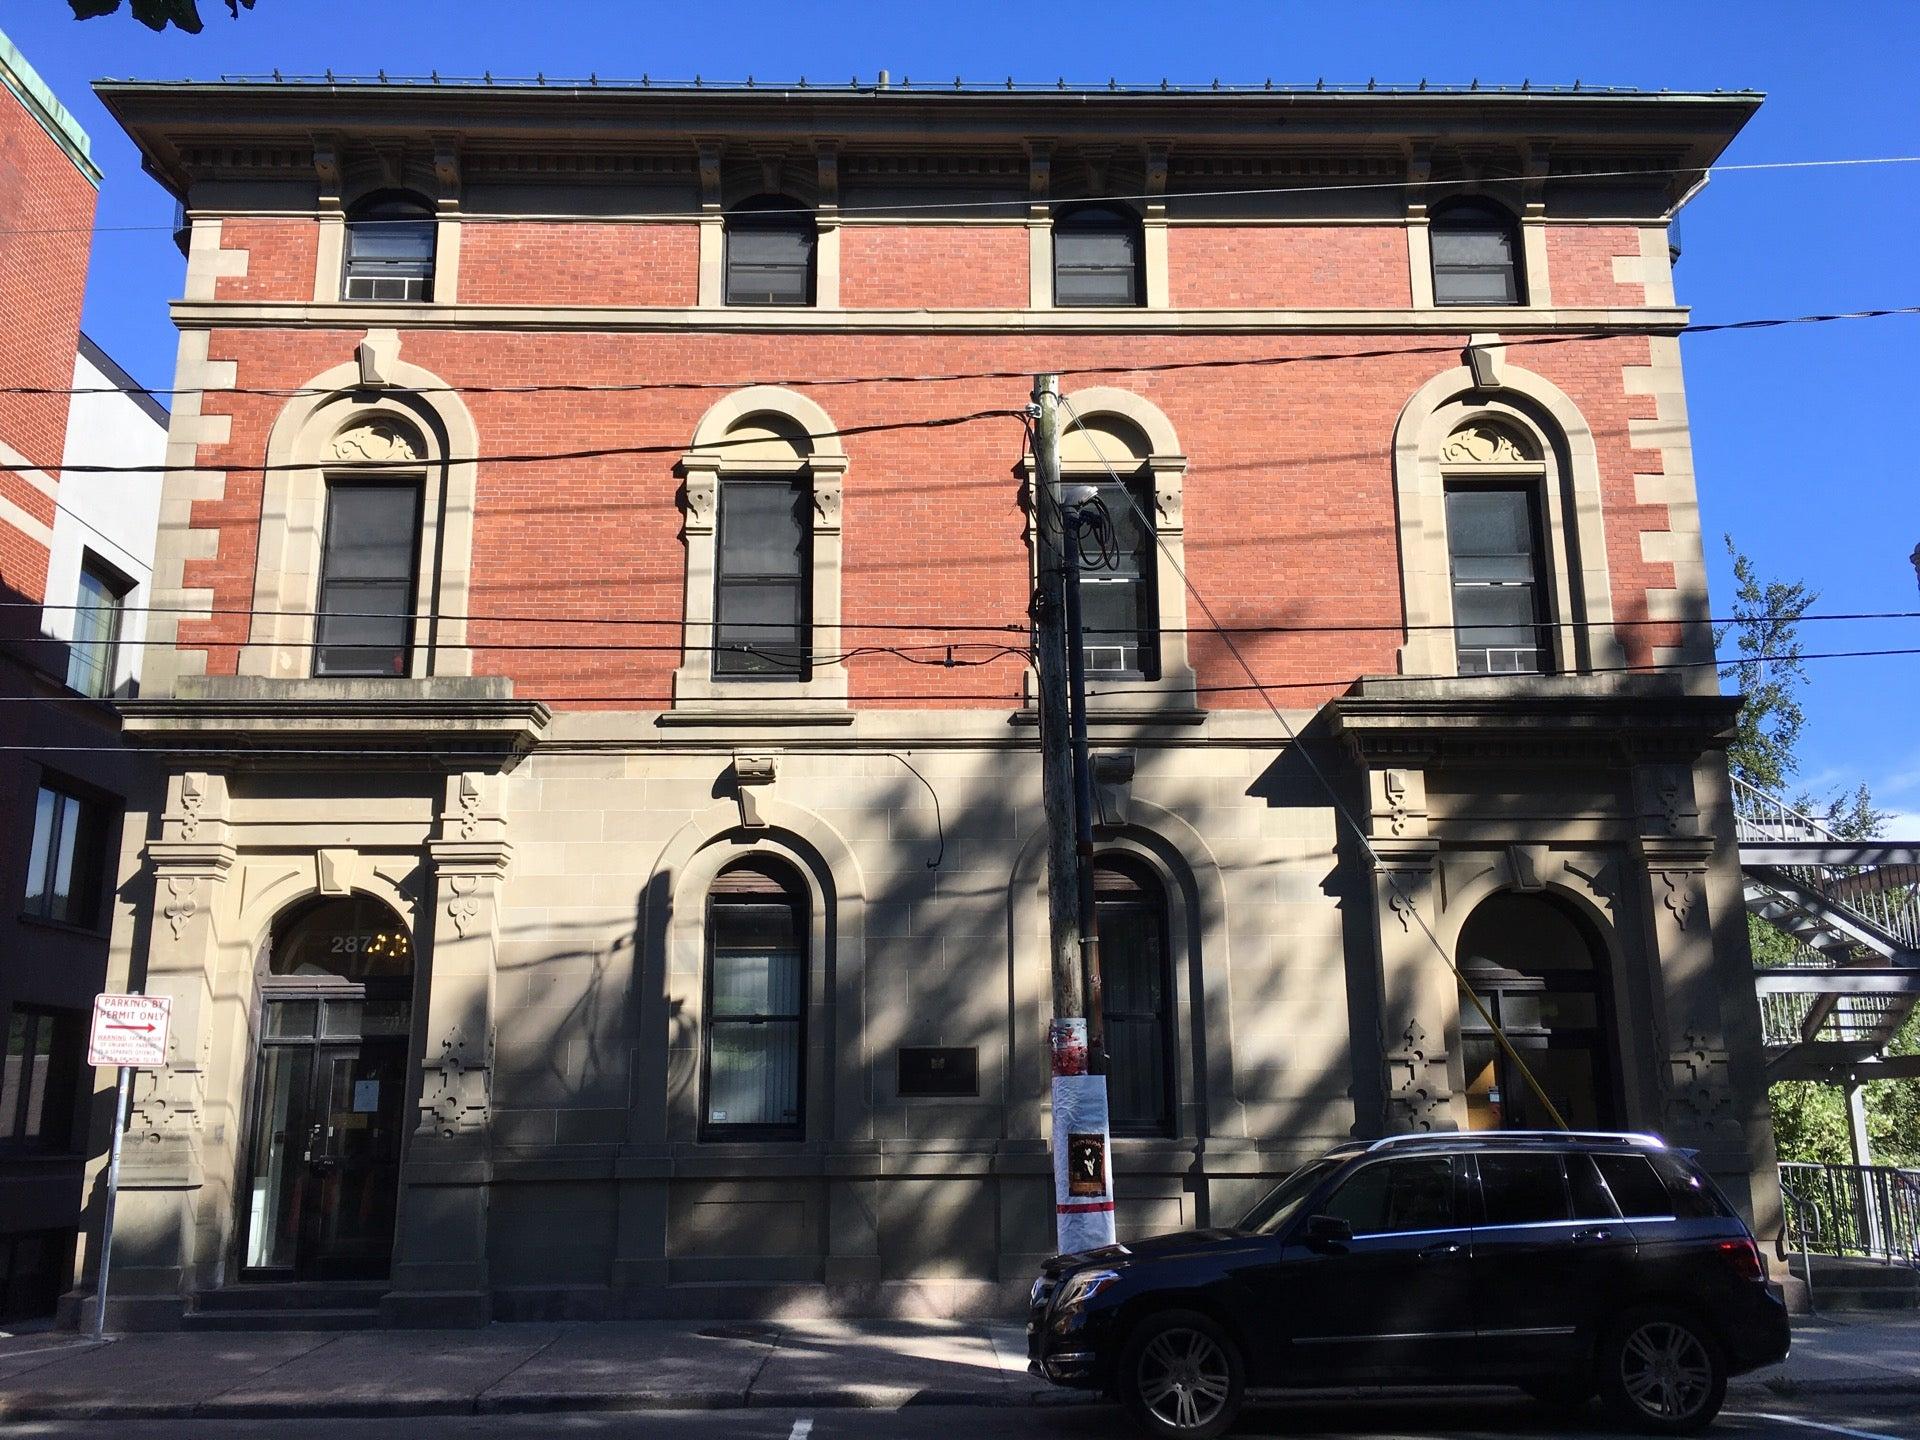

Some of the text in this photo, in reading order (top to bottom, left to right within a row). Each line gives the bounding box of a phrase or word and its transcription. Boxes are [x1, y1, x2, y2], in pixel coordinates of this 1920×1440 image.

[331, 936, 372, 953] 287
[104, 998, 164, 1009] PARKING BY
[100, 1010, 165, 1021] PERMIT ONLY
